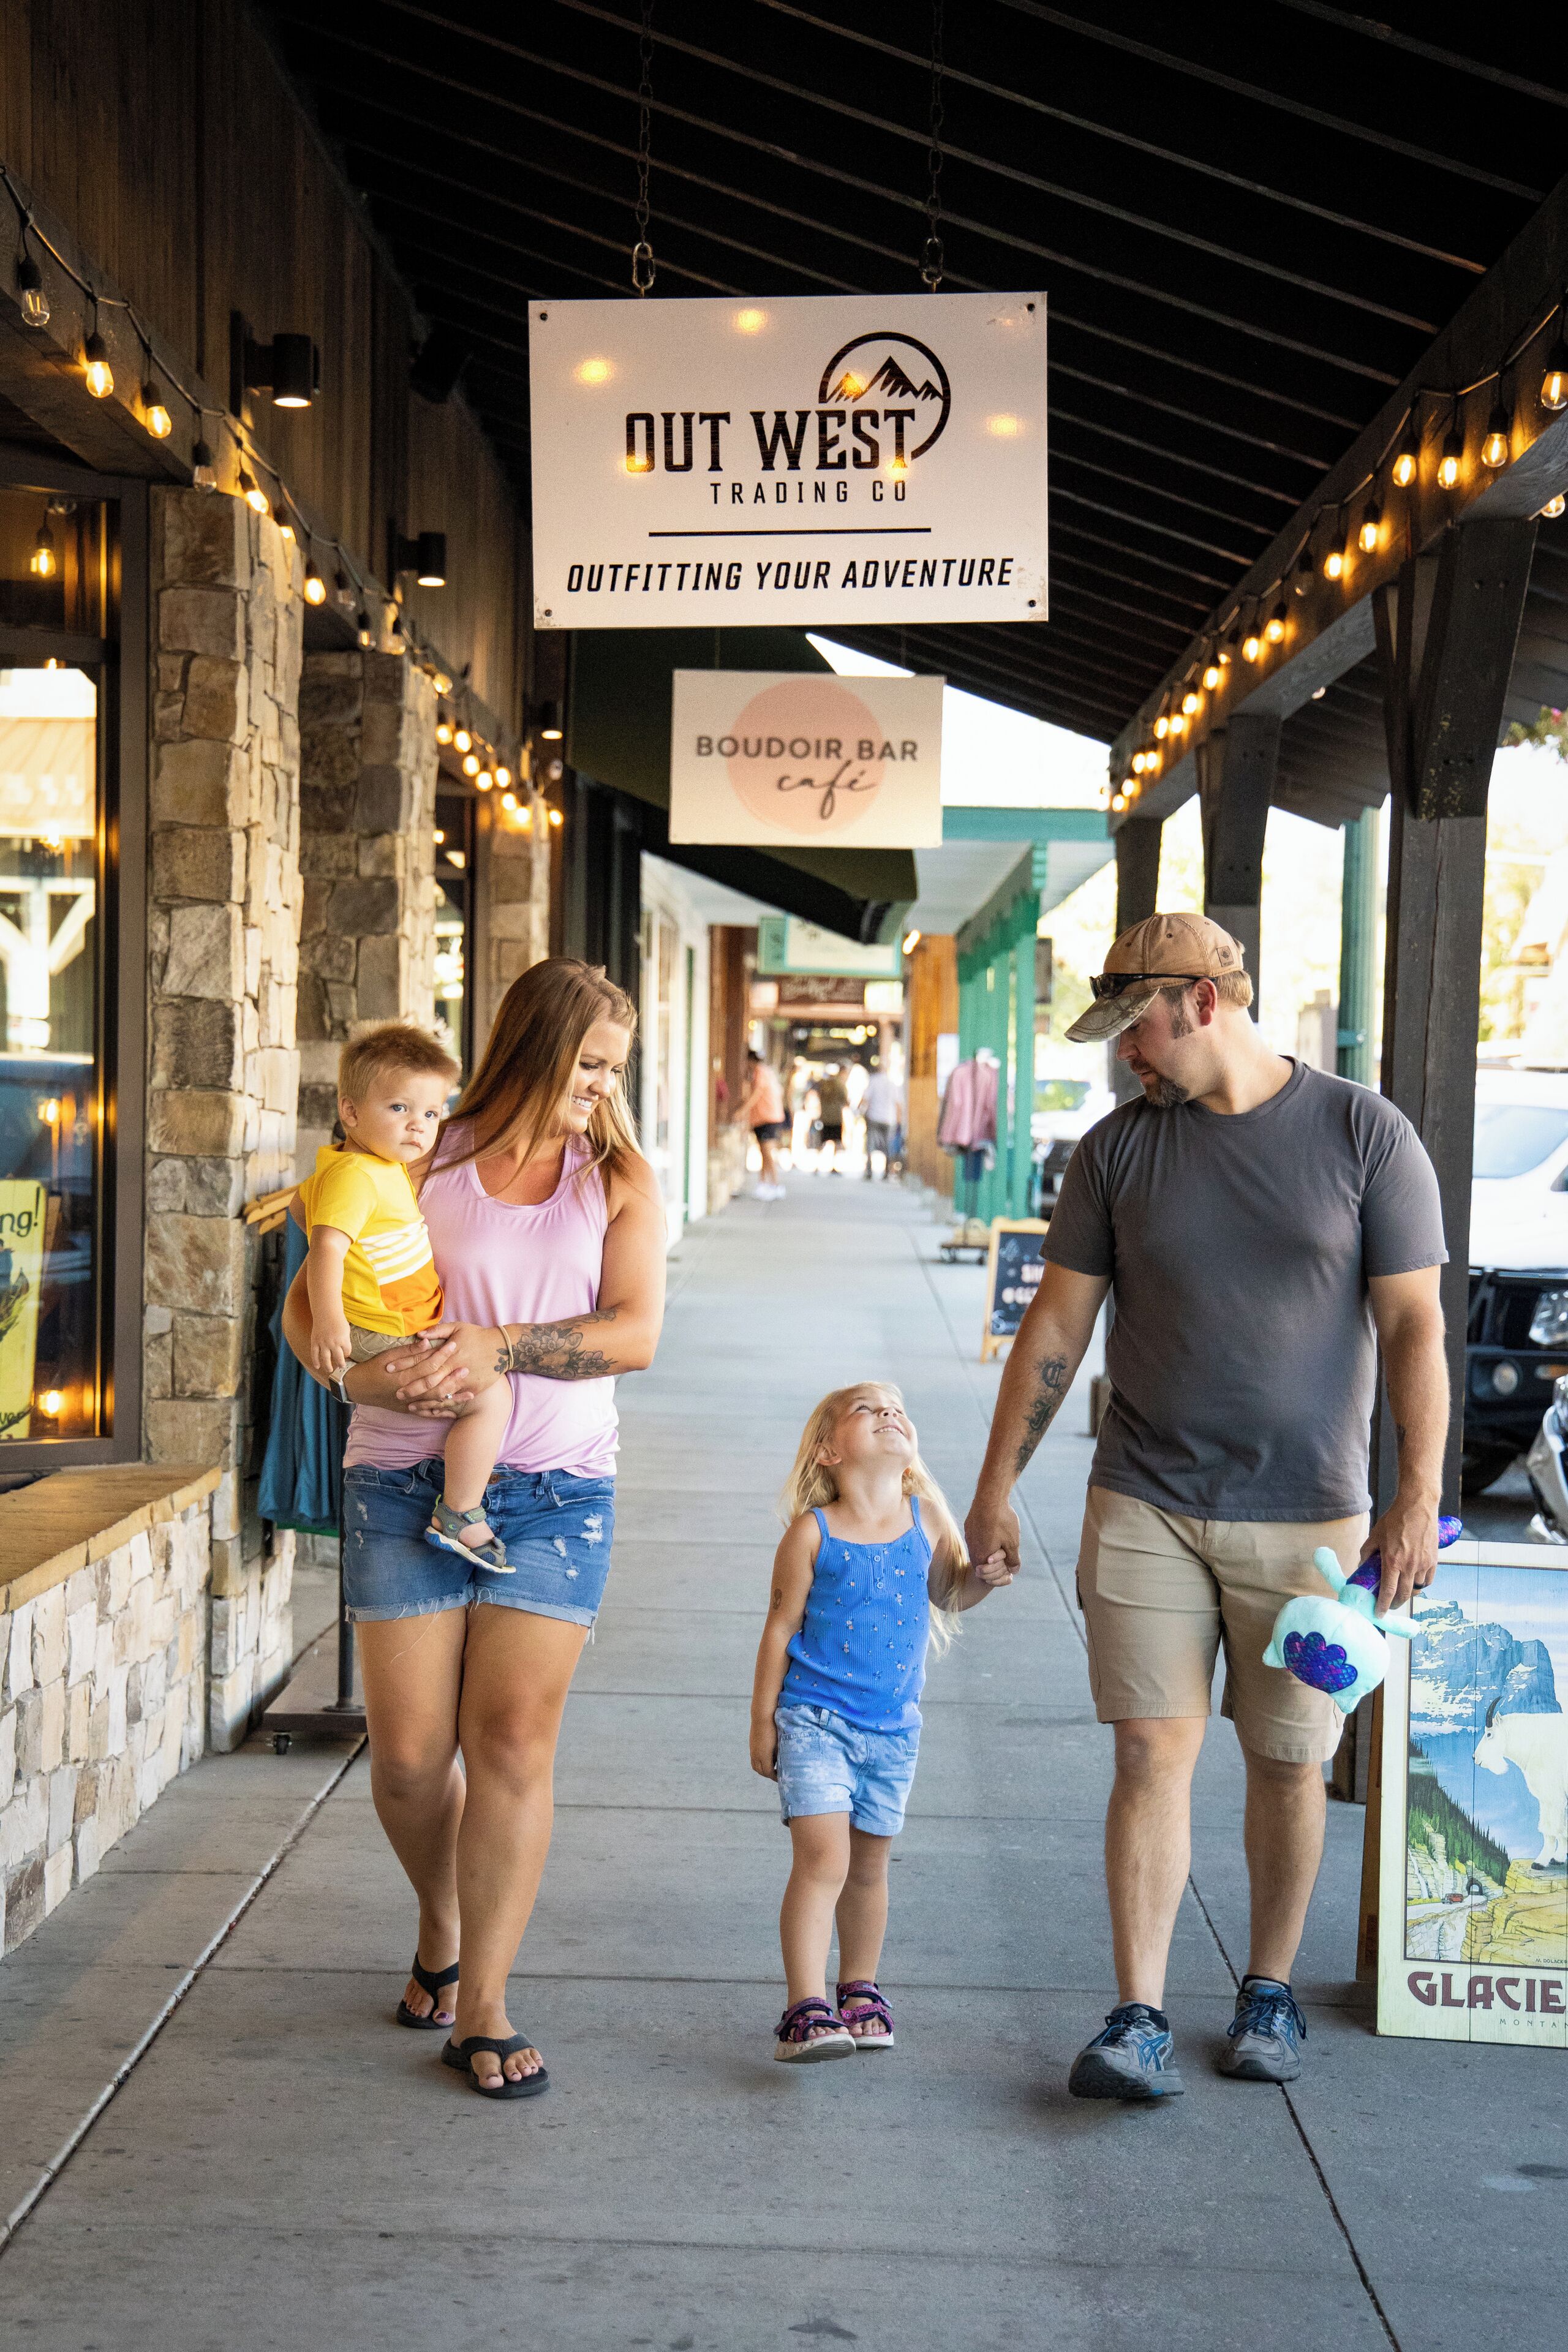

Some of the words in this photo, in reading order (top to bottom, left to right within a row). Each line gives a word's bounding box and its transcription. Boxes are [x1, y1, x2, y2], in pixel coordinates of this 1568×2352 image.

[625, 411, 731, 473] OUT
[749, 408, 916, 471] WEST
[710, 481, 848, 505] TRADING
[872, 480, 906, 502] CO
[567, 562, 742, 592] OUTFITTING
[756, 561, 831, 590] YOUR
[841, 558, 1014, 589] ADVENTURE
[696, 736, 843, 759] BOUDOIR
[858, 739, 918, 761] BAR
[776, 759, 878, 820] café
[1408, 1971, 1566, 2014] GLACIE
